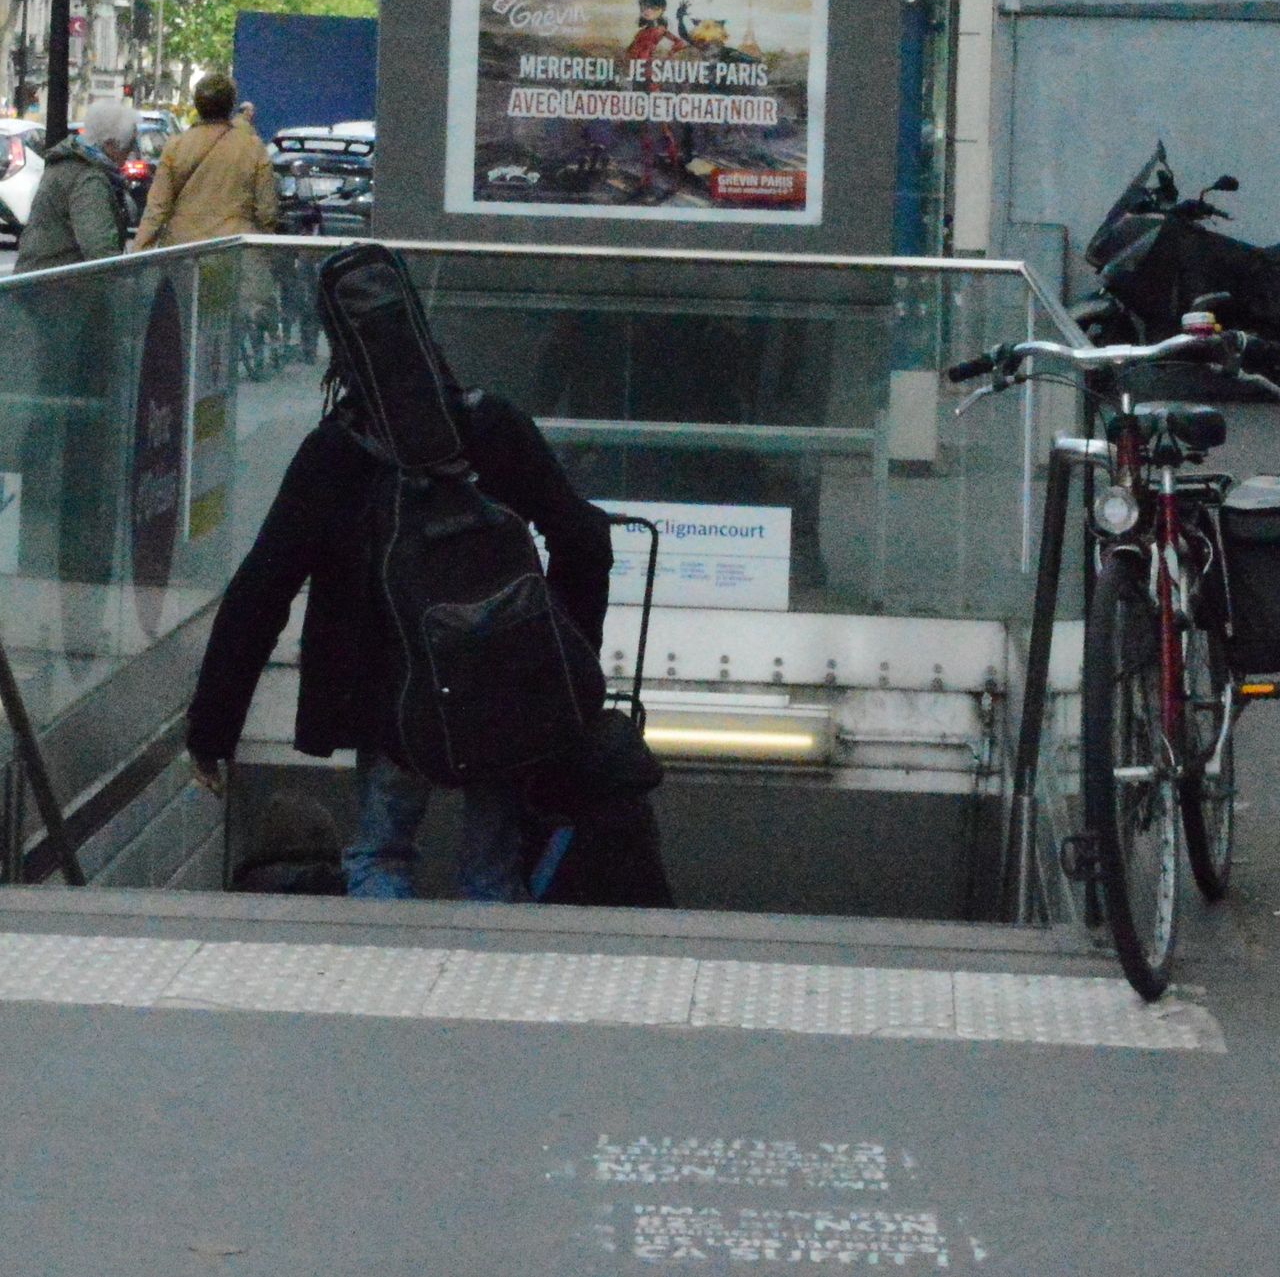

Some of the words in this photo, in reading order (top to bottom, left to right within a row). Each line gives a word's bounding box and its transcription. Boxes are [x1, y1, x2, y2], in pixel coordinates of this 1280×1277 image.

[519, 55, 619, 83] MERCREDI,
[626, 59, 646, 82] JE
[651, 59, 711, 84] SAUVE
[715, 62, 769, 87] PARIS
[510, 89, 559, 115] AVEC
[564, 91, 646, 118] LADYBUG
[651, 94, 673, 119] ET
[677, 95, 726, 120] CHAT
[729, 97, 776, 123] NOIR
[654, 519, 766, 539] Clignancourt
